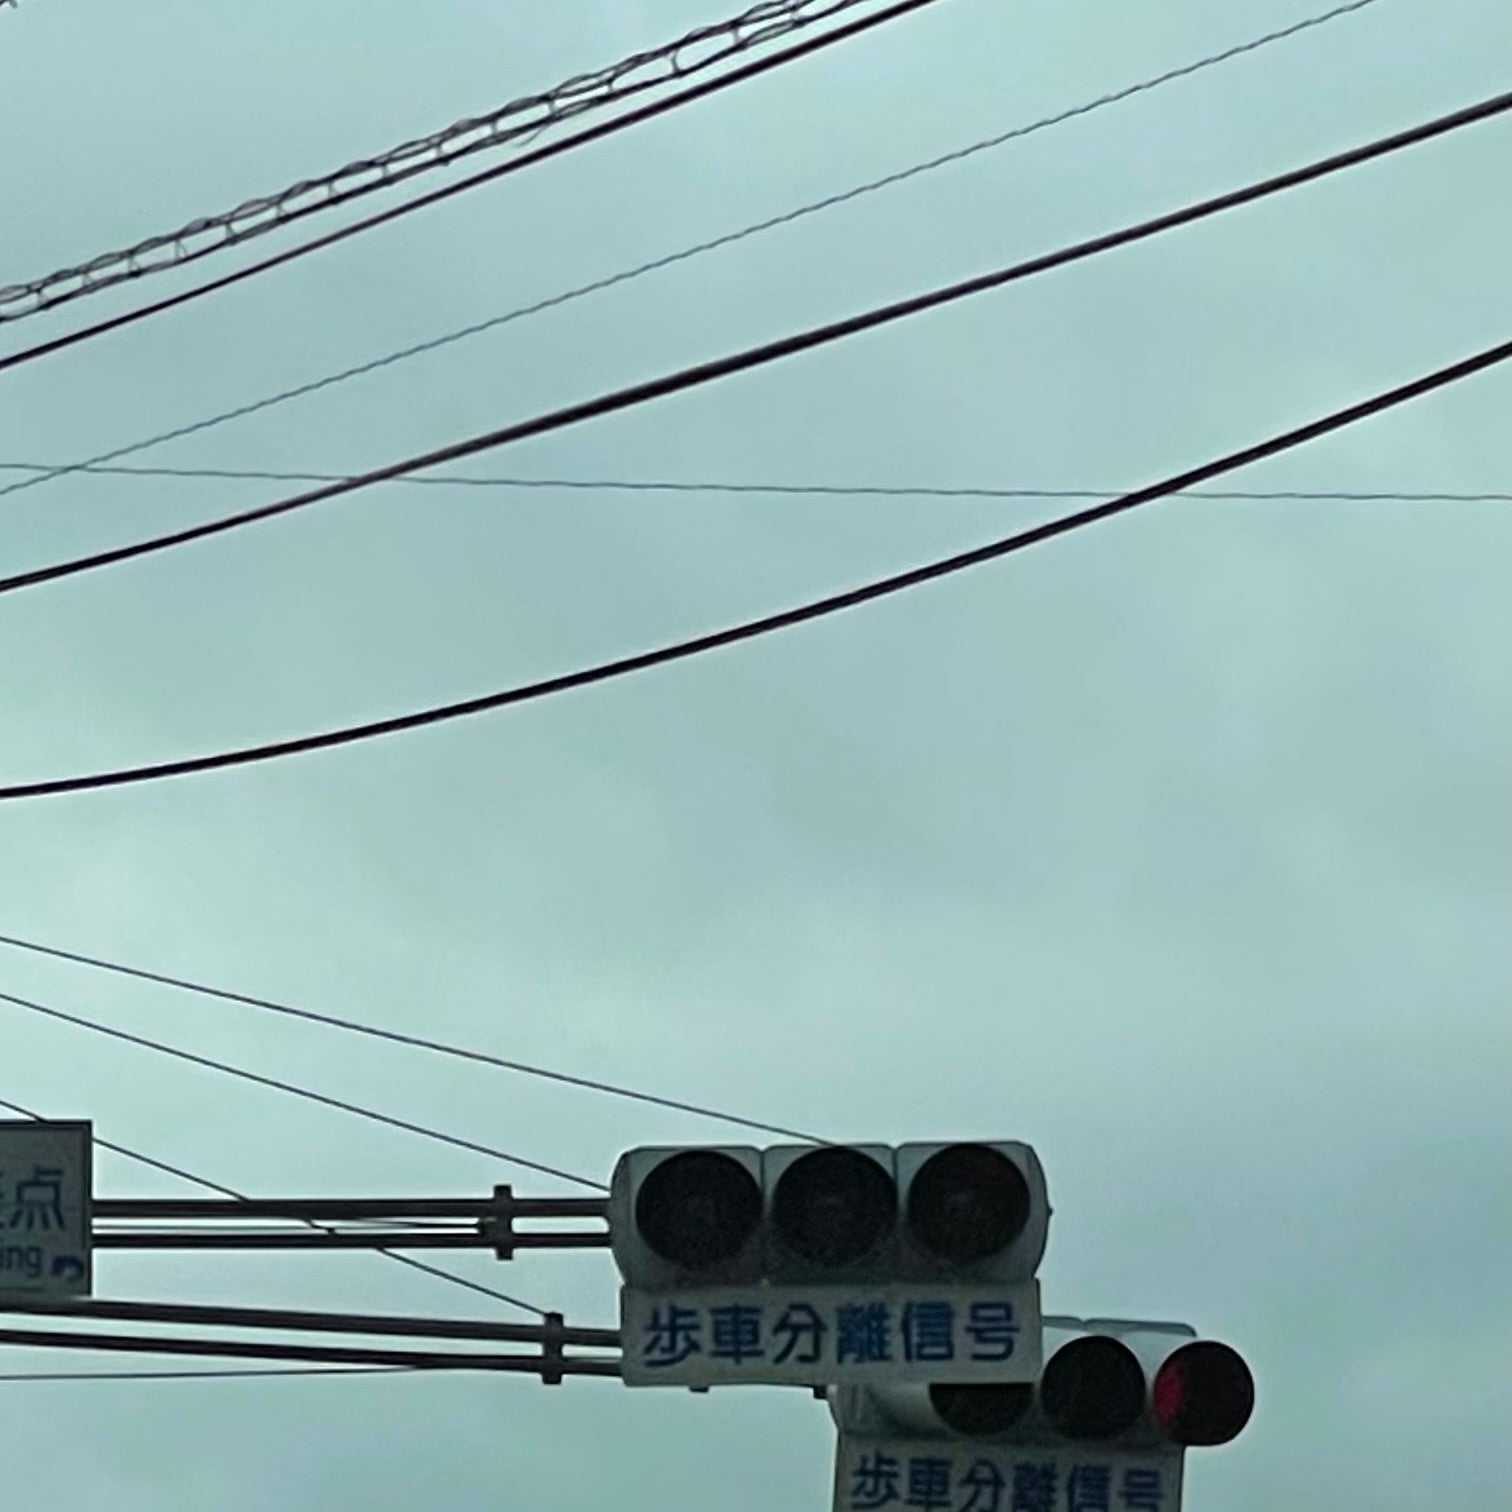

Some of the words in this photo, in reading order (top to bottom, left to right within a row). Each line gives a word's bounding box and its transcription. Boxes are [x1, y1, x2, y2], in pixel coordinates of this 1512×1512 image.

[642, 1299, 1022, 1367] 歩車分離信号
